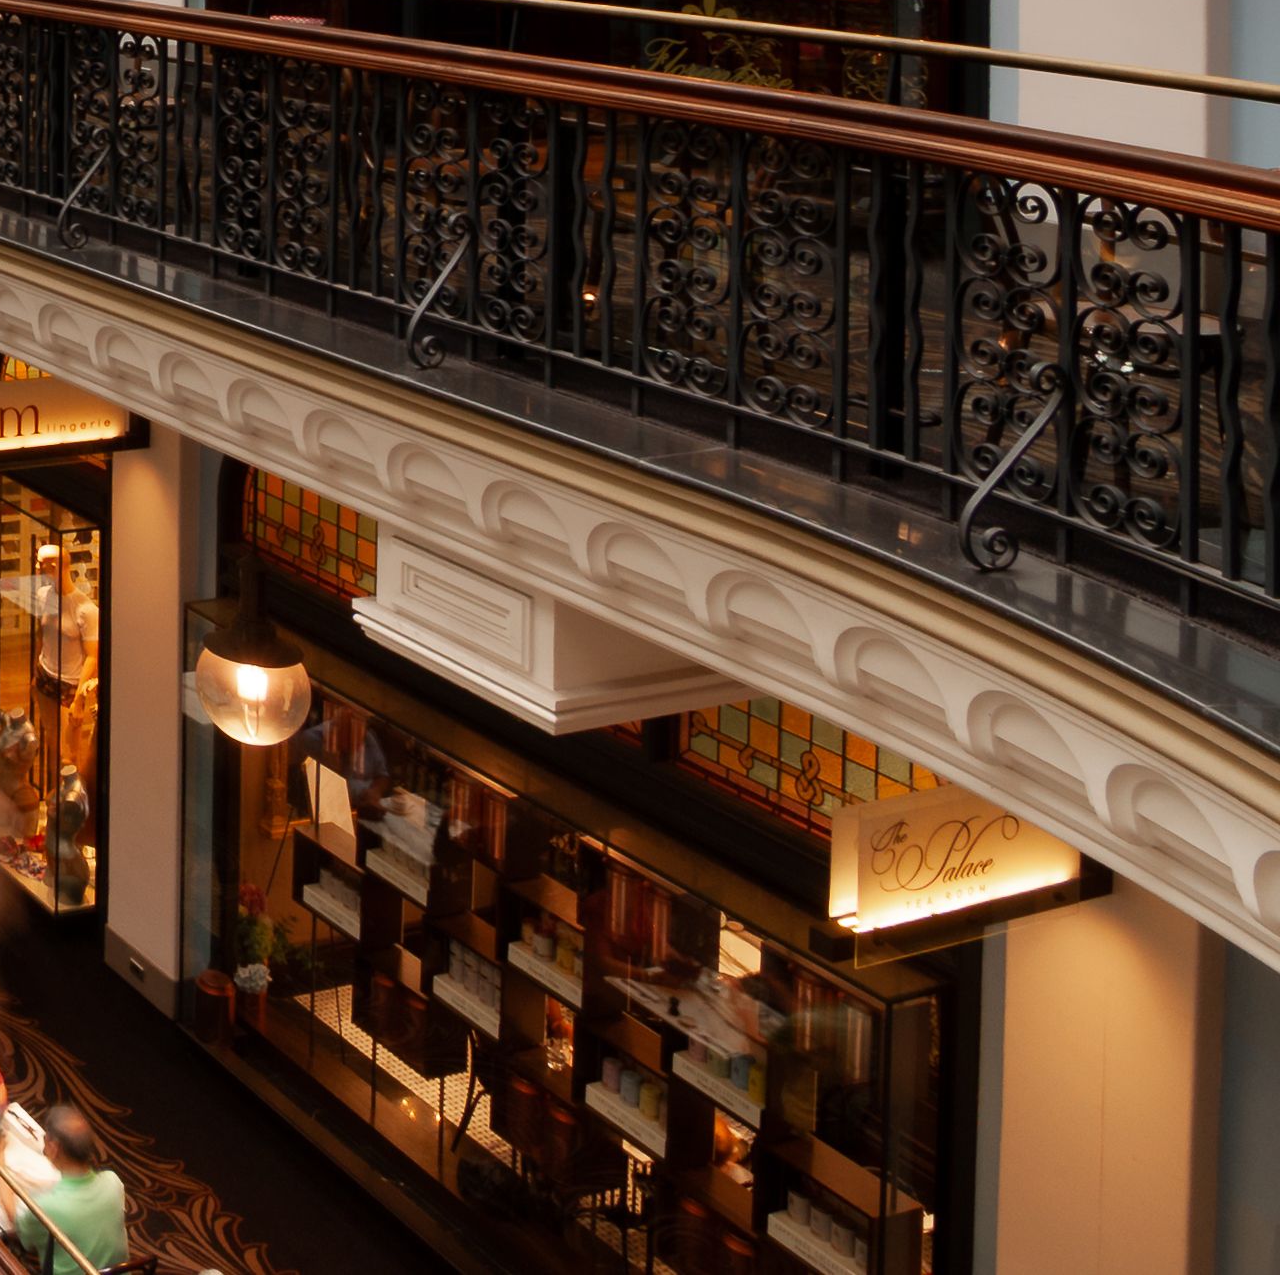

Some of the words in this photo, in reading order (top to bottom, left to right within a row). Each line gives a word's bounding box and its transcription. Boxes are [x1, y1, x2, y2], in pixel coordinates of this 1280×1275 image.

[46, 419, 112, 434] lingerie
[870, 819, 910, 863] The
[880, 815, 1019, 892] Palace
